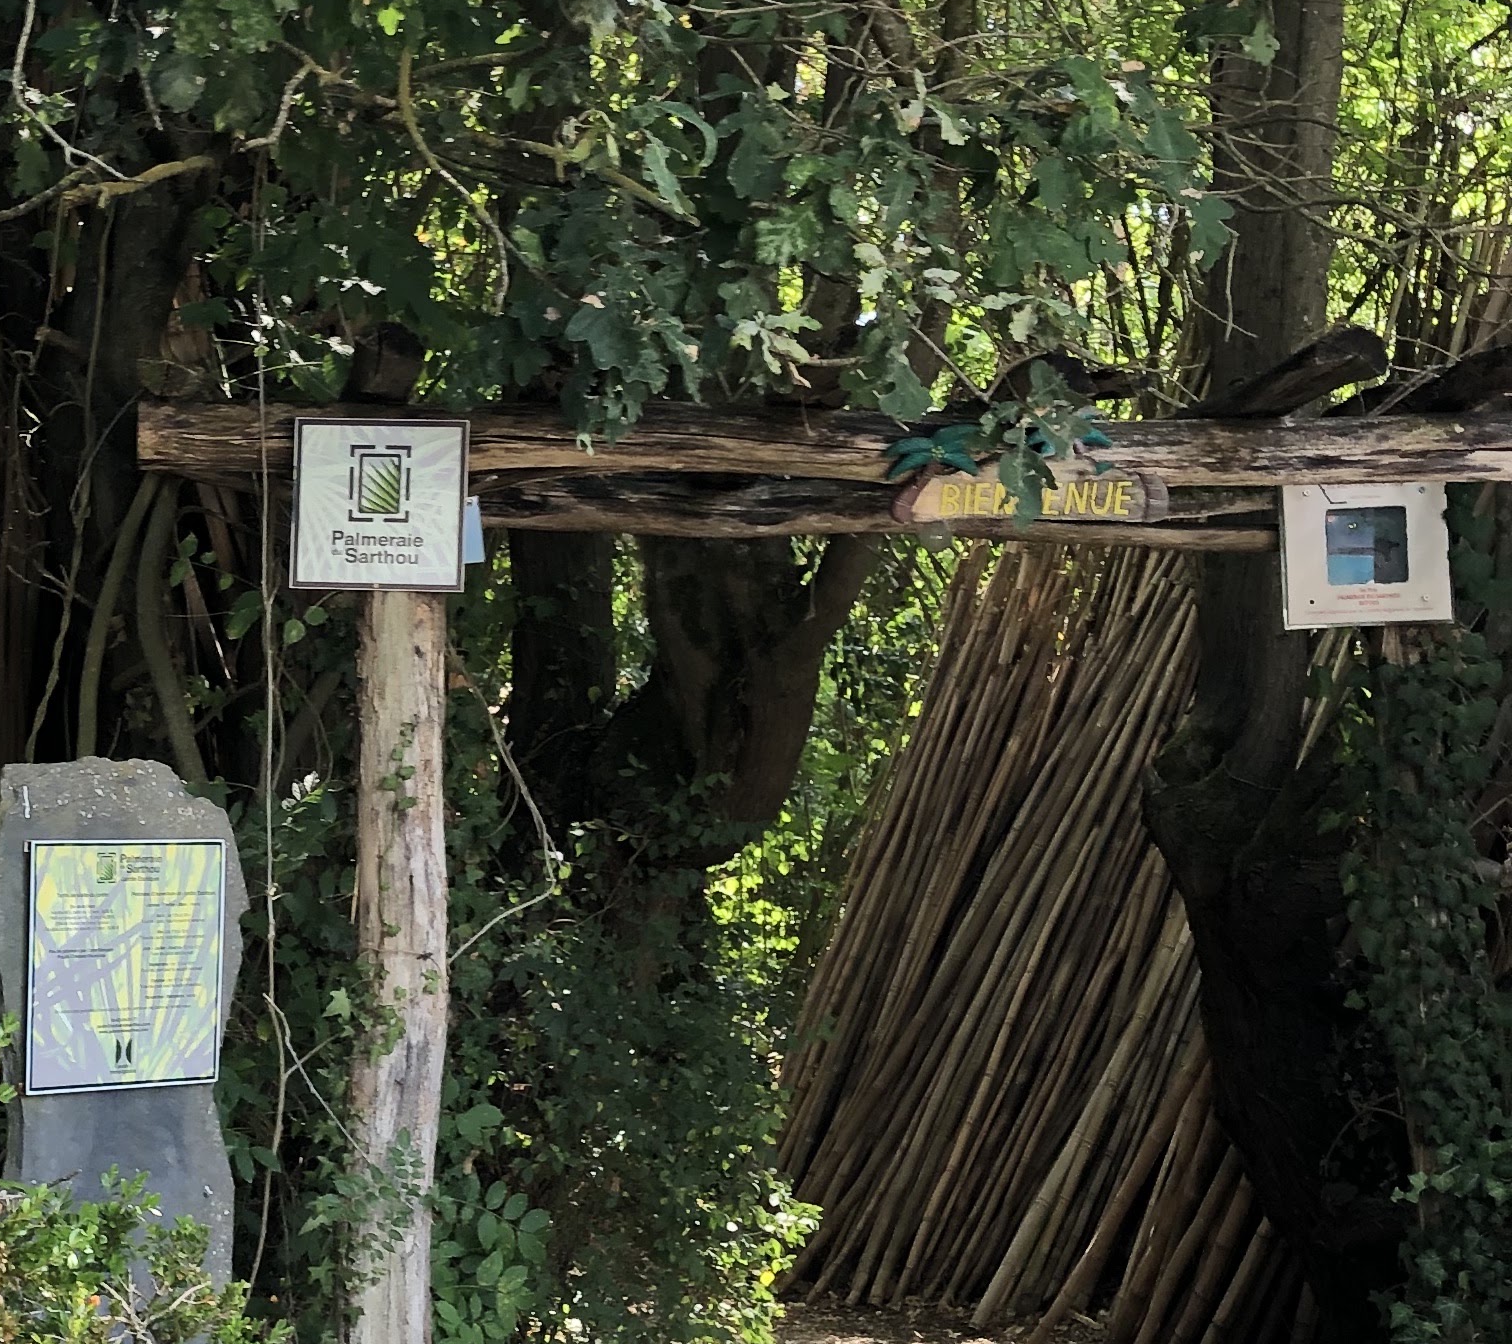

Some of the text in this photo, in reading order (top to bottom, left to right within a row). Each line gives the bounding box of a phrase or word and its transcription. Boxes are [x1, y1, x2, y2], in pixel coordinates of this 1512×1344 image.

[940, 481, 1133, 517] BIENENUE
[331, 530, 424, 548] Palmeraie
[345, 547, 419, 565] Sarthou
